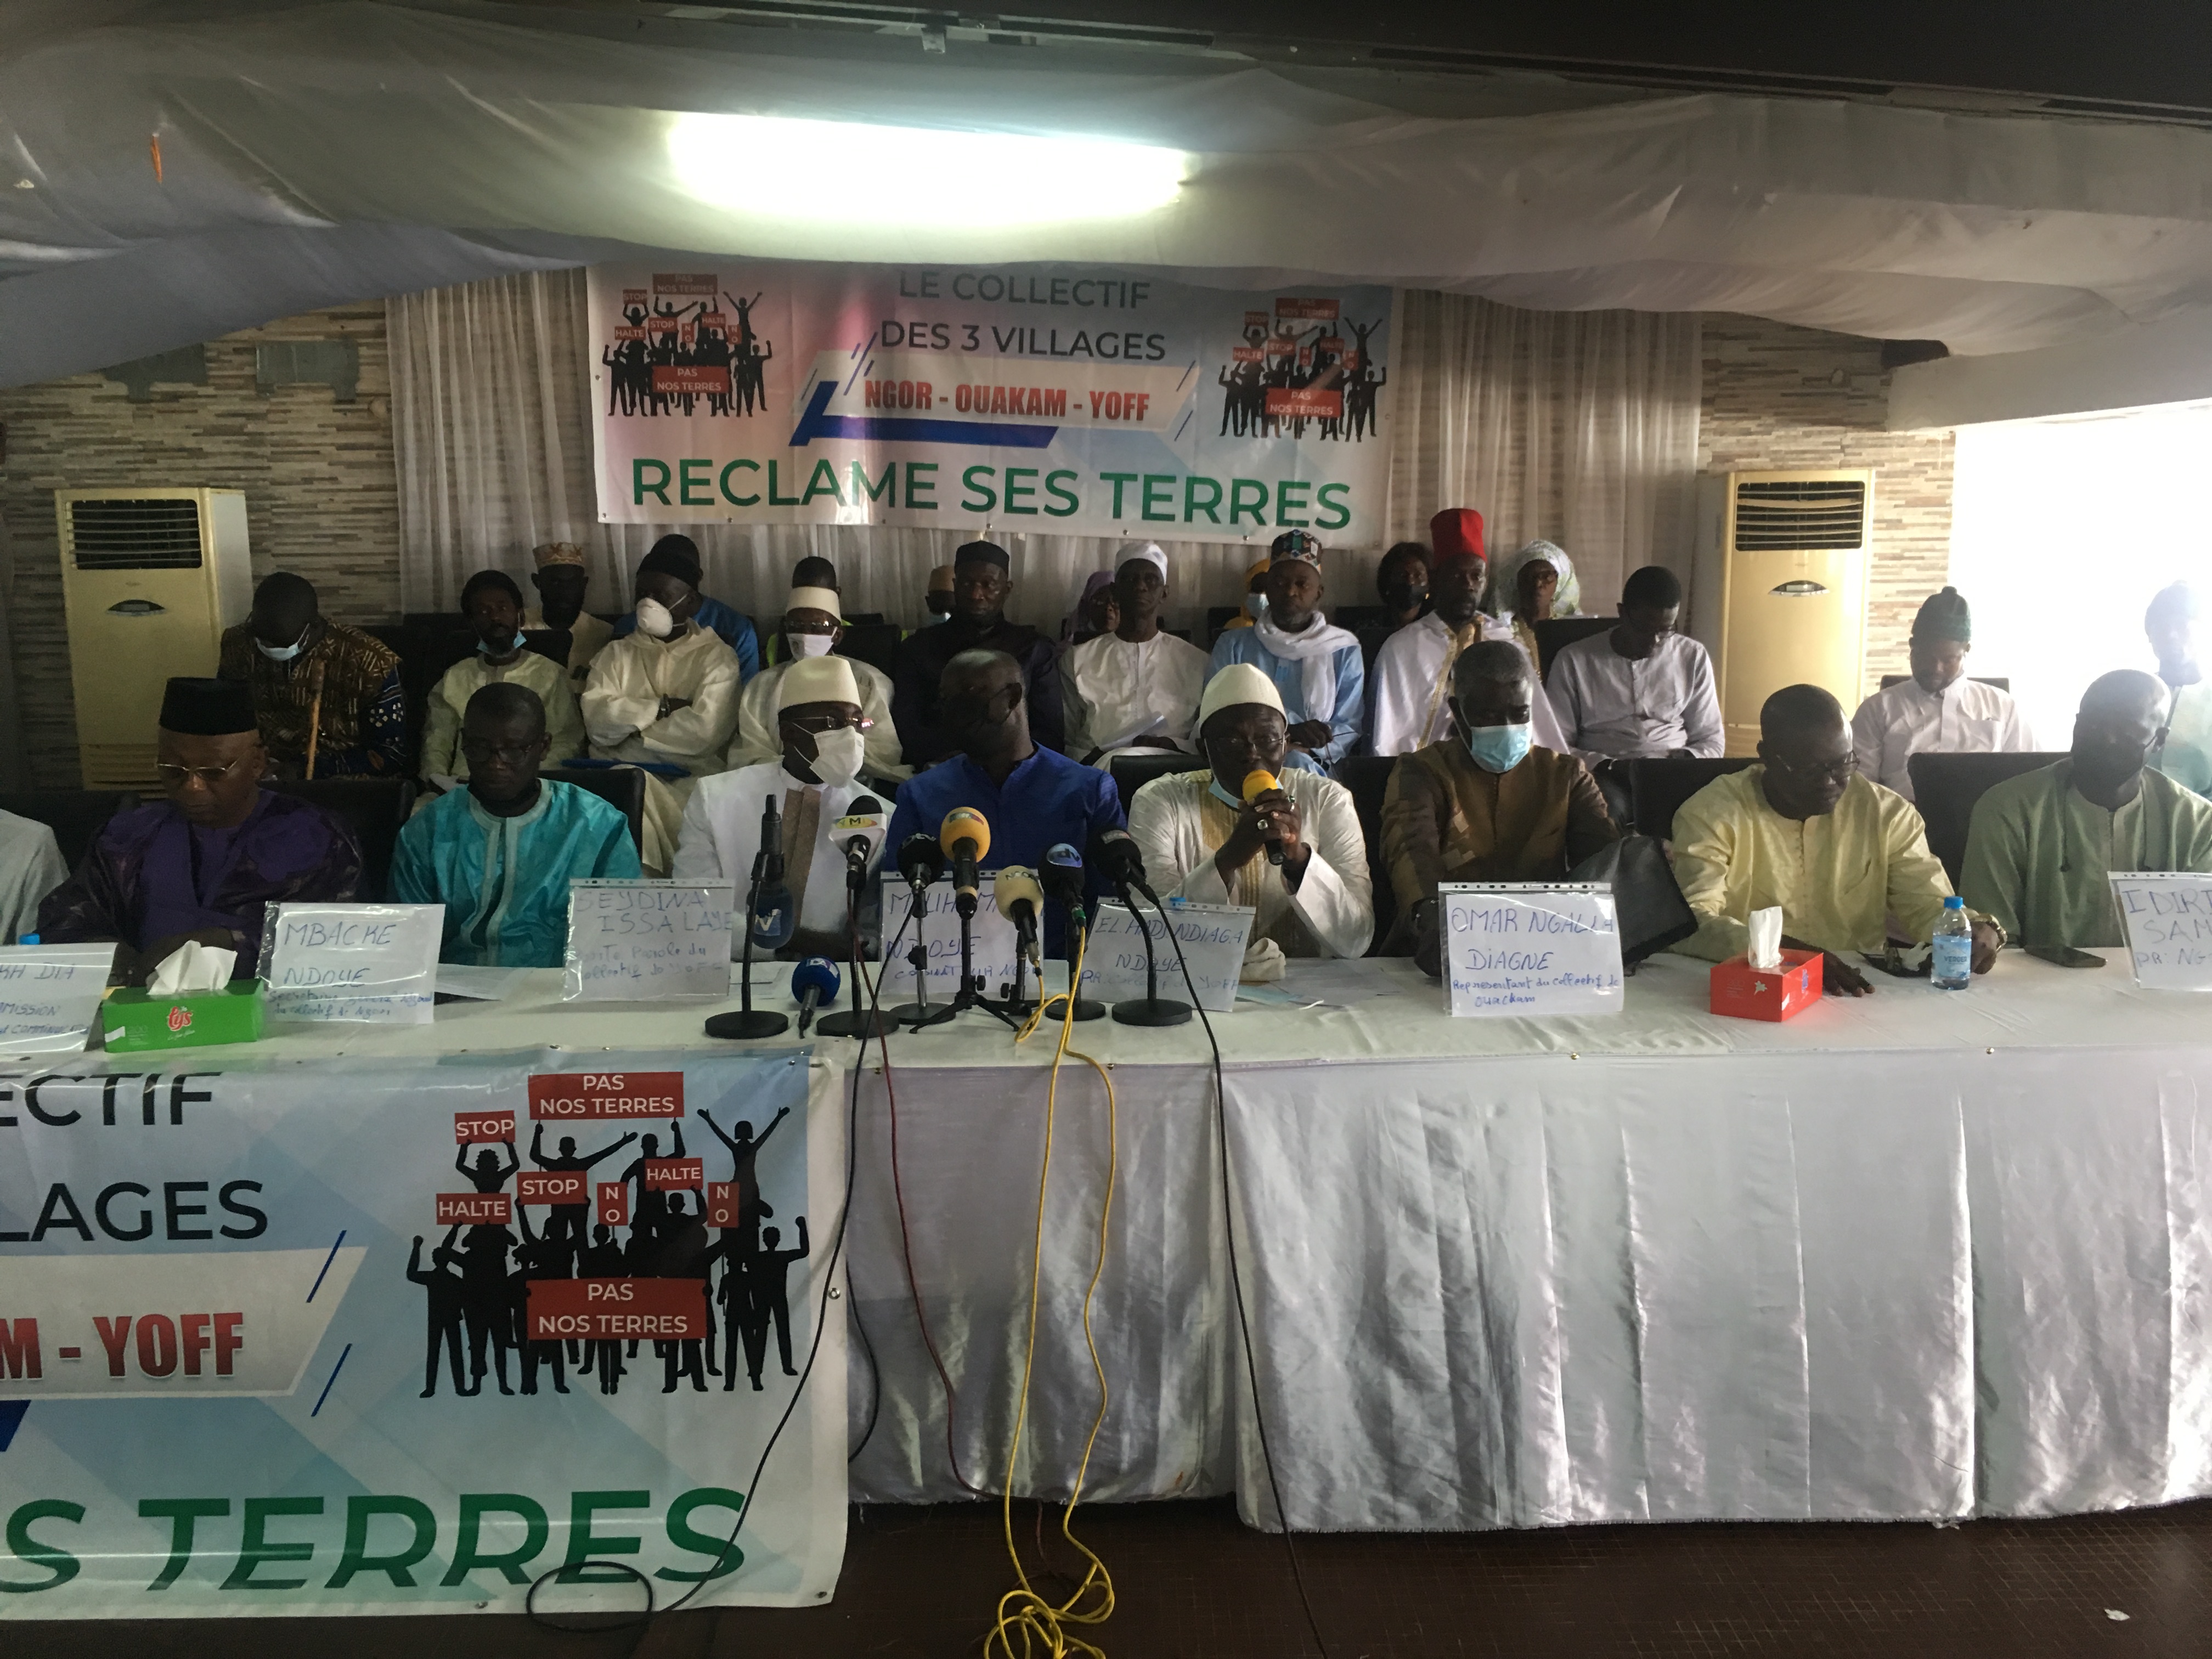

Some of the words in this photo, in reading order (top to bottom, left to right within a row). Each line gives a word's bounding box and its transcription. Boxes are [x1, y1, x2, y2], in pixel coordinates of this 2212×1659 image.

[900, 271, 939, 298] LE
[952, 273, 1150, 308] COLLECTIF
[882, 320, 950, 351] DES
[961, 325, 980, 352] 3
[992, 326, 1166, 361] VILLAGES
[1269, 343, 1293, 352] STOP
[657, 382, 679, 391] NOS
[683, 382, 721, 391] TERRES
[865, 380, 932, 410] NGOR
[955, 384, 1066, 417] OUAKAM
[1090, 391, 1149, 421] YOFF
[1291, 392, 1311, 400] PAS
[1270, 404, 1291, 413] NOS
[1295, 405, 1333, 415] TERRES
[633, 459, 939, 510] RECLAME
[961, 465, 1080, 517] SES
[1100, 472, 1351, 530] TERRES
[1452, 907, 1517, 932] OMAR
[583, 1075, 624, 1091] PAS
[540, 1098, 585, 1114] NOS
[591, 1097, 674, 1114] TERRES
[456, 1119, 514, 1137] STOP
[647, 1166, 701, 1182] HALTE
[522, 1180, 579, 1195] STOP
[439, 1201, 506, 1217] HALTE
[588, 1284, 633, 1301] PAS
[539, 1316, 590, 1334] NOS
[596, 1315, 688, 1334] TERRES
[92, 1312, 244, 1379] YOFF
[0, 1498, 86, 1594] S
[138, 1487, 746, 1592] TERRES
